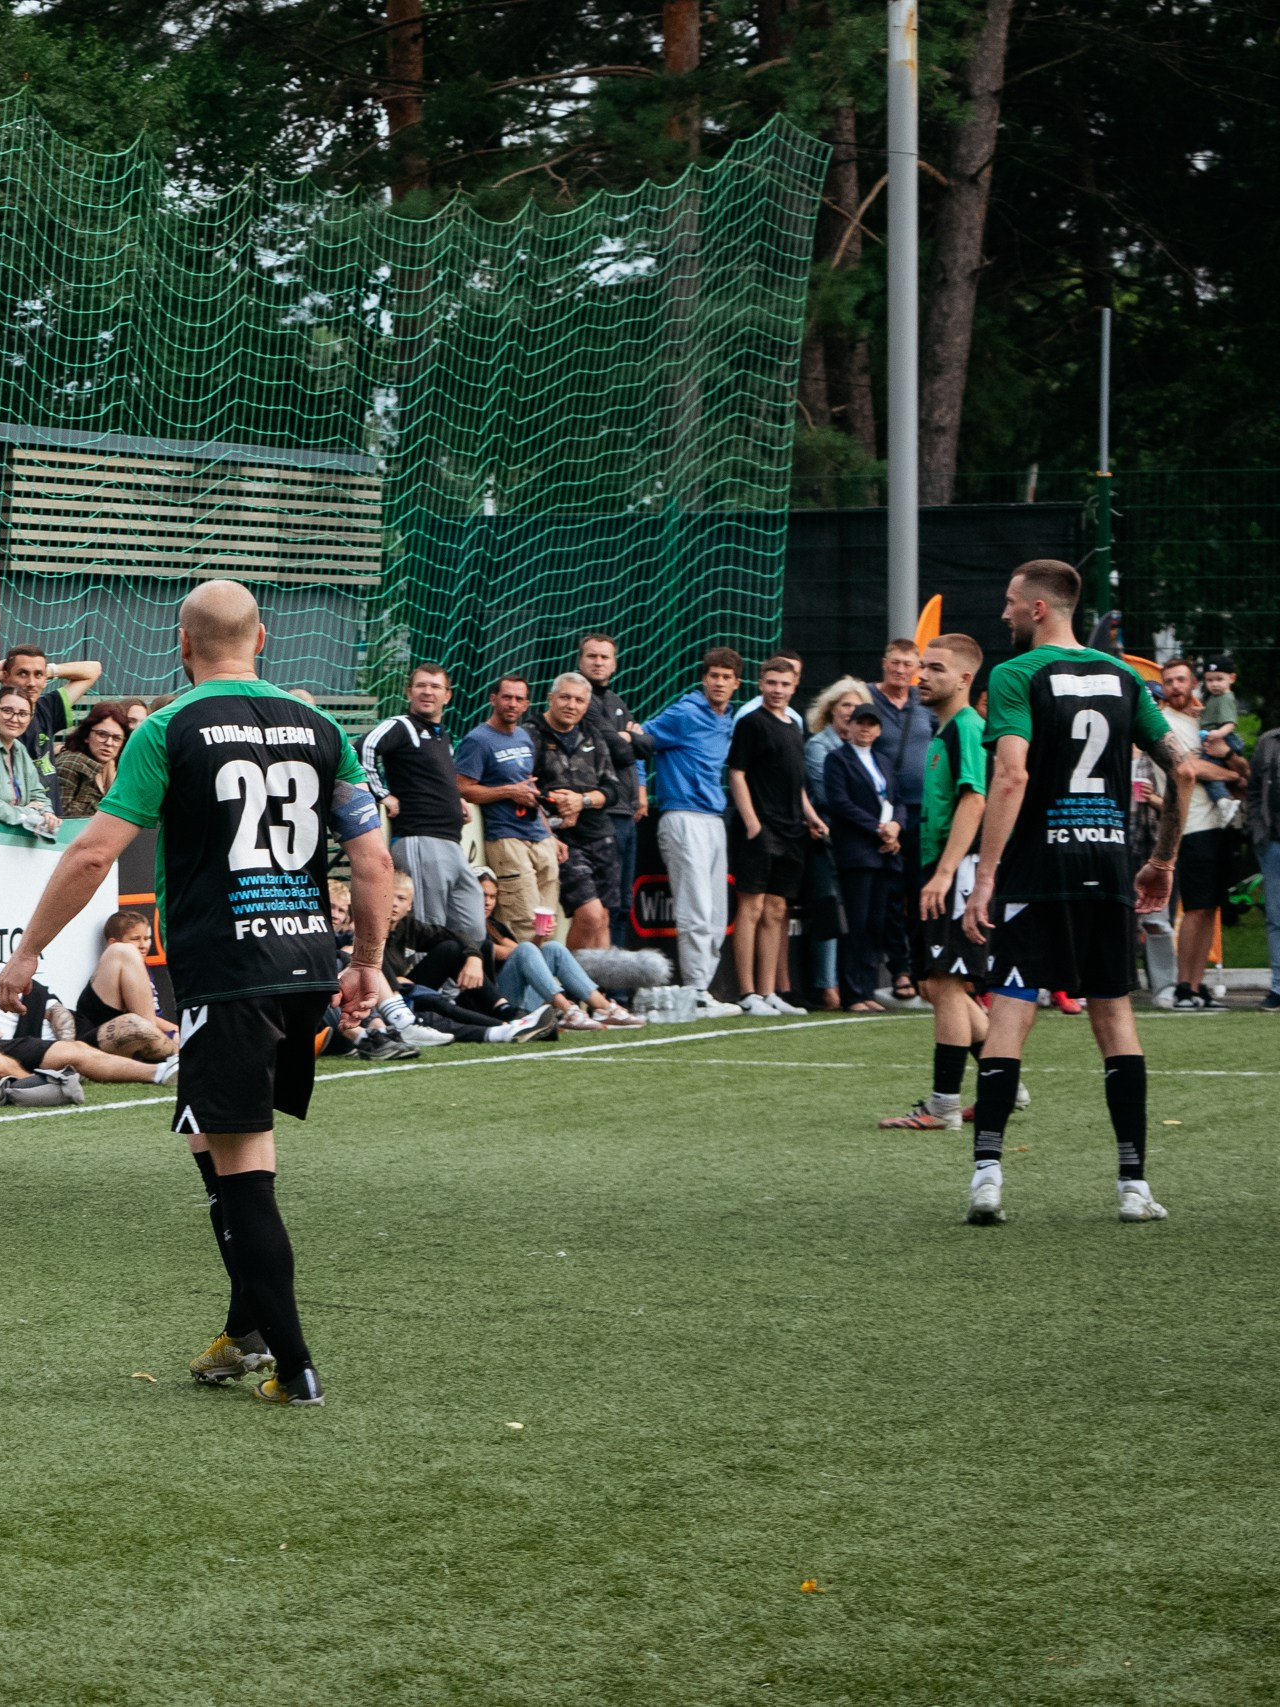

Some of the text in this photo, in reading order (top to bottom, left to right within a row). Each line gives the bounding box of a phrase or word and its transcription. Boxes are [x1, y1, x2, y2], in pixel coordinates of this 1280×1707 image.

[199, 725, 264, 746] ТОЛЬКО
[1069, 708, 1110, 793] 2
[215, 759, 320, 872] 23
[1047, 827, 1126, 844] FC VOLAT
[234, 914, 328, 940] FC VOLAT
